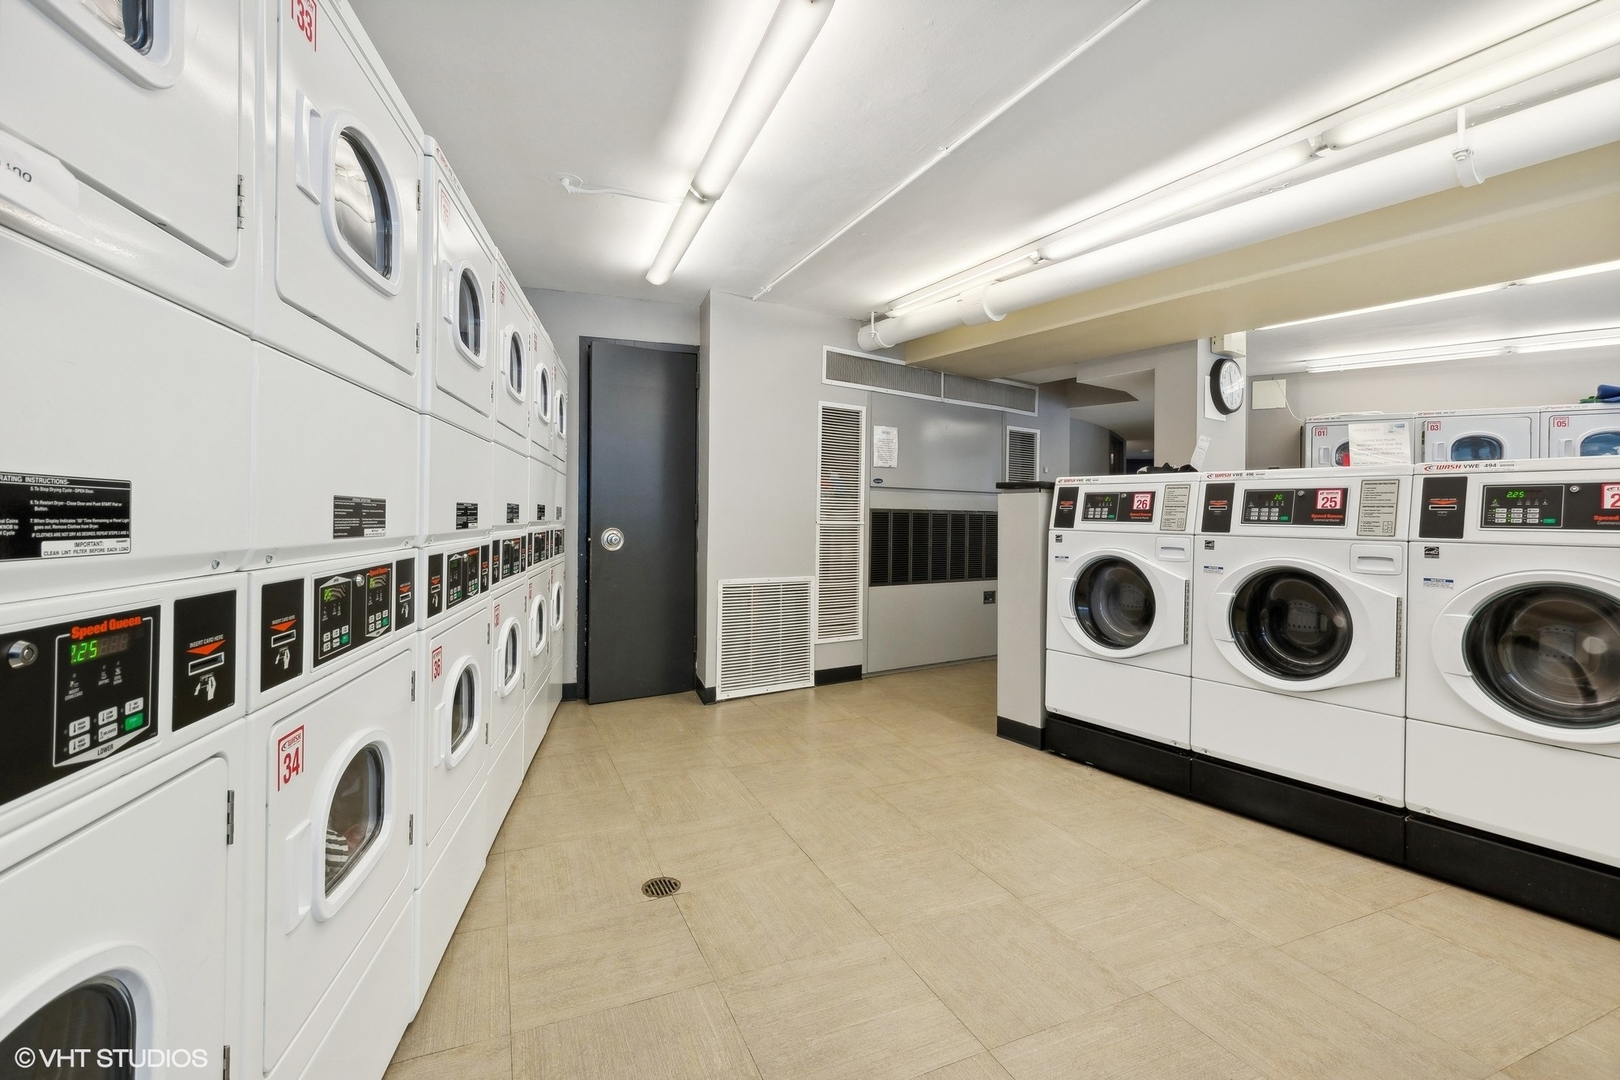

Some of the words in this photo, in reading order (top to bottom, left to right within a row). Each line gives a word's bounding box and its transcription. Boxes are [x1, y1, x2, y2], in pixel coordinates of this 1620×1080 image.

[296, 0, 313, 43] 33
[1136, 499, 1148, 509] 26
[1321, 497, 1338, 508] 25
[71, 622, 108, 640] Speed
[109, 616, 141, 629] Queen
[189, 640, 203, 649] INSERT
[203, 637, 214, 645] CARD
[214, 634, 224, 642] HERE
[97, 744, 114, 756] LOWER
[283, 747, 300, 784] 34
